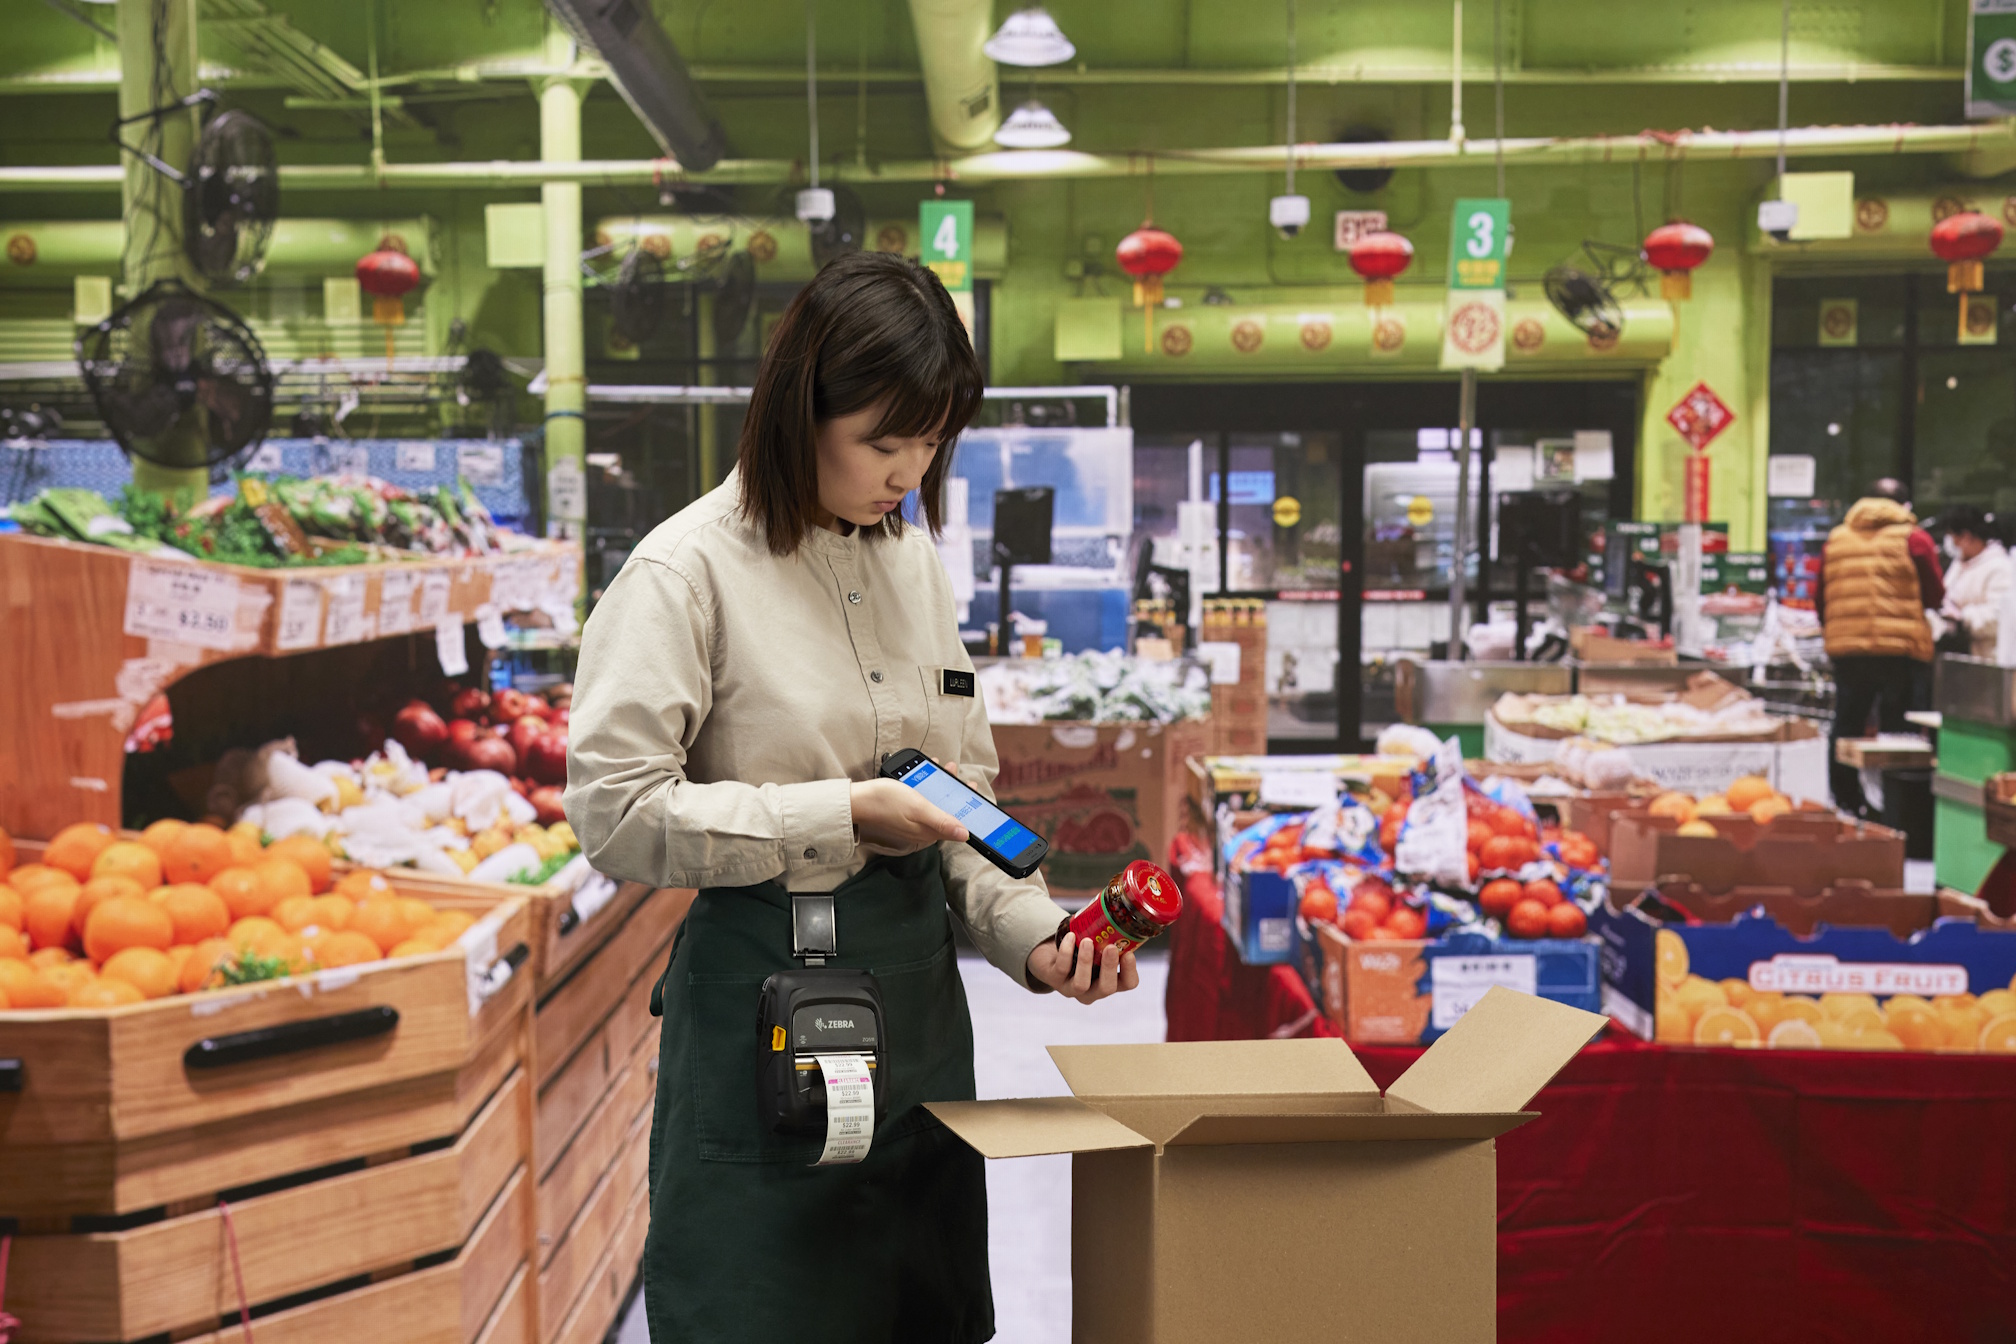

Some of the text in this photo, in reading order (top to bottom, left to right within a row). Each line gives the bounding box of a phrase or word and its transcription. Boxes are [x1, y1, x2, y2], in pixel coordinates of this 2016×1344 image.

[932, 214, 960, 259] 4
[1467, 211, 1494, 258] 3
[827, 1020, 855, 1029] ZEBRA
